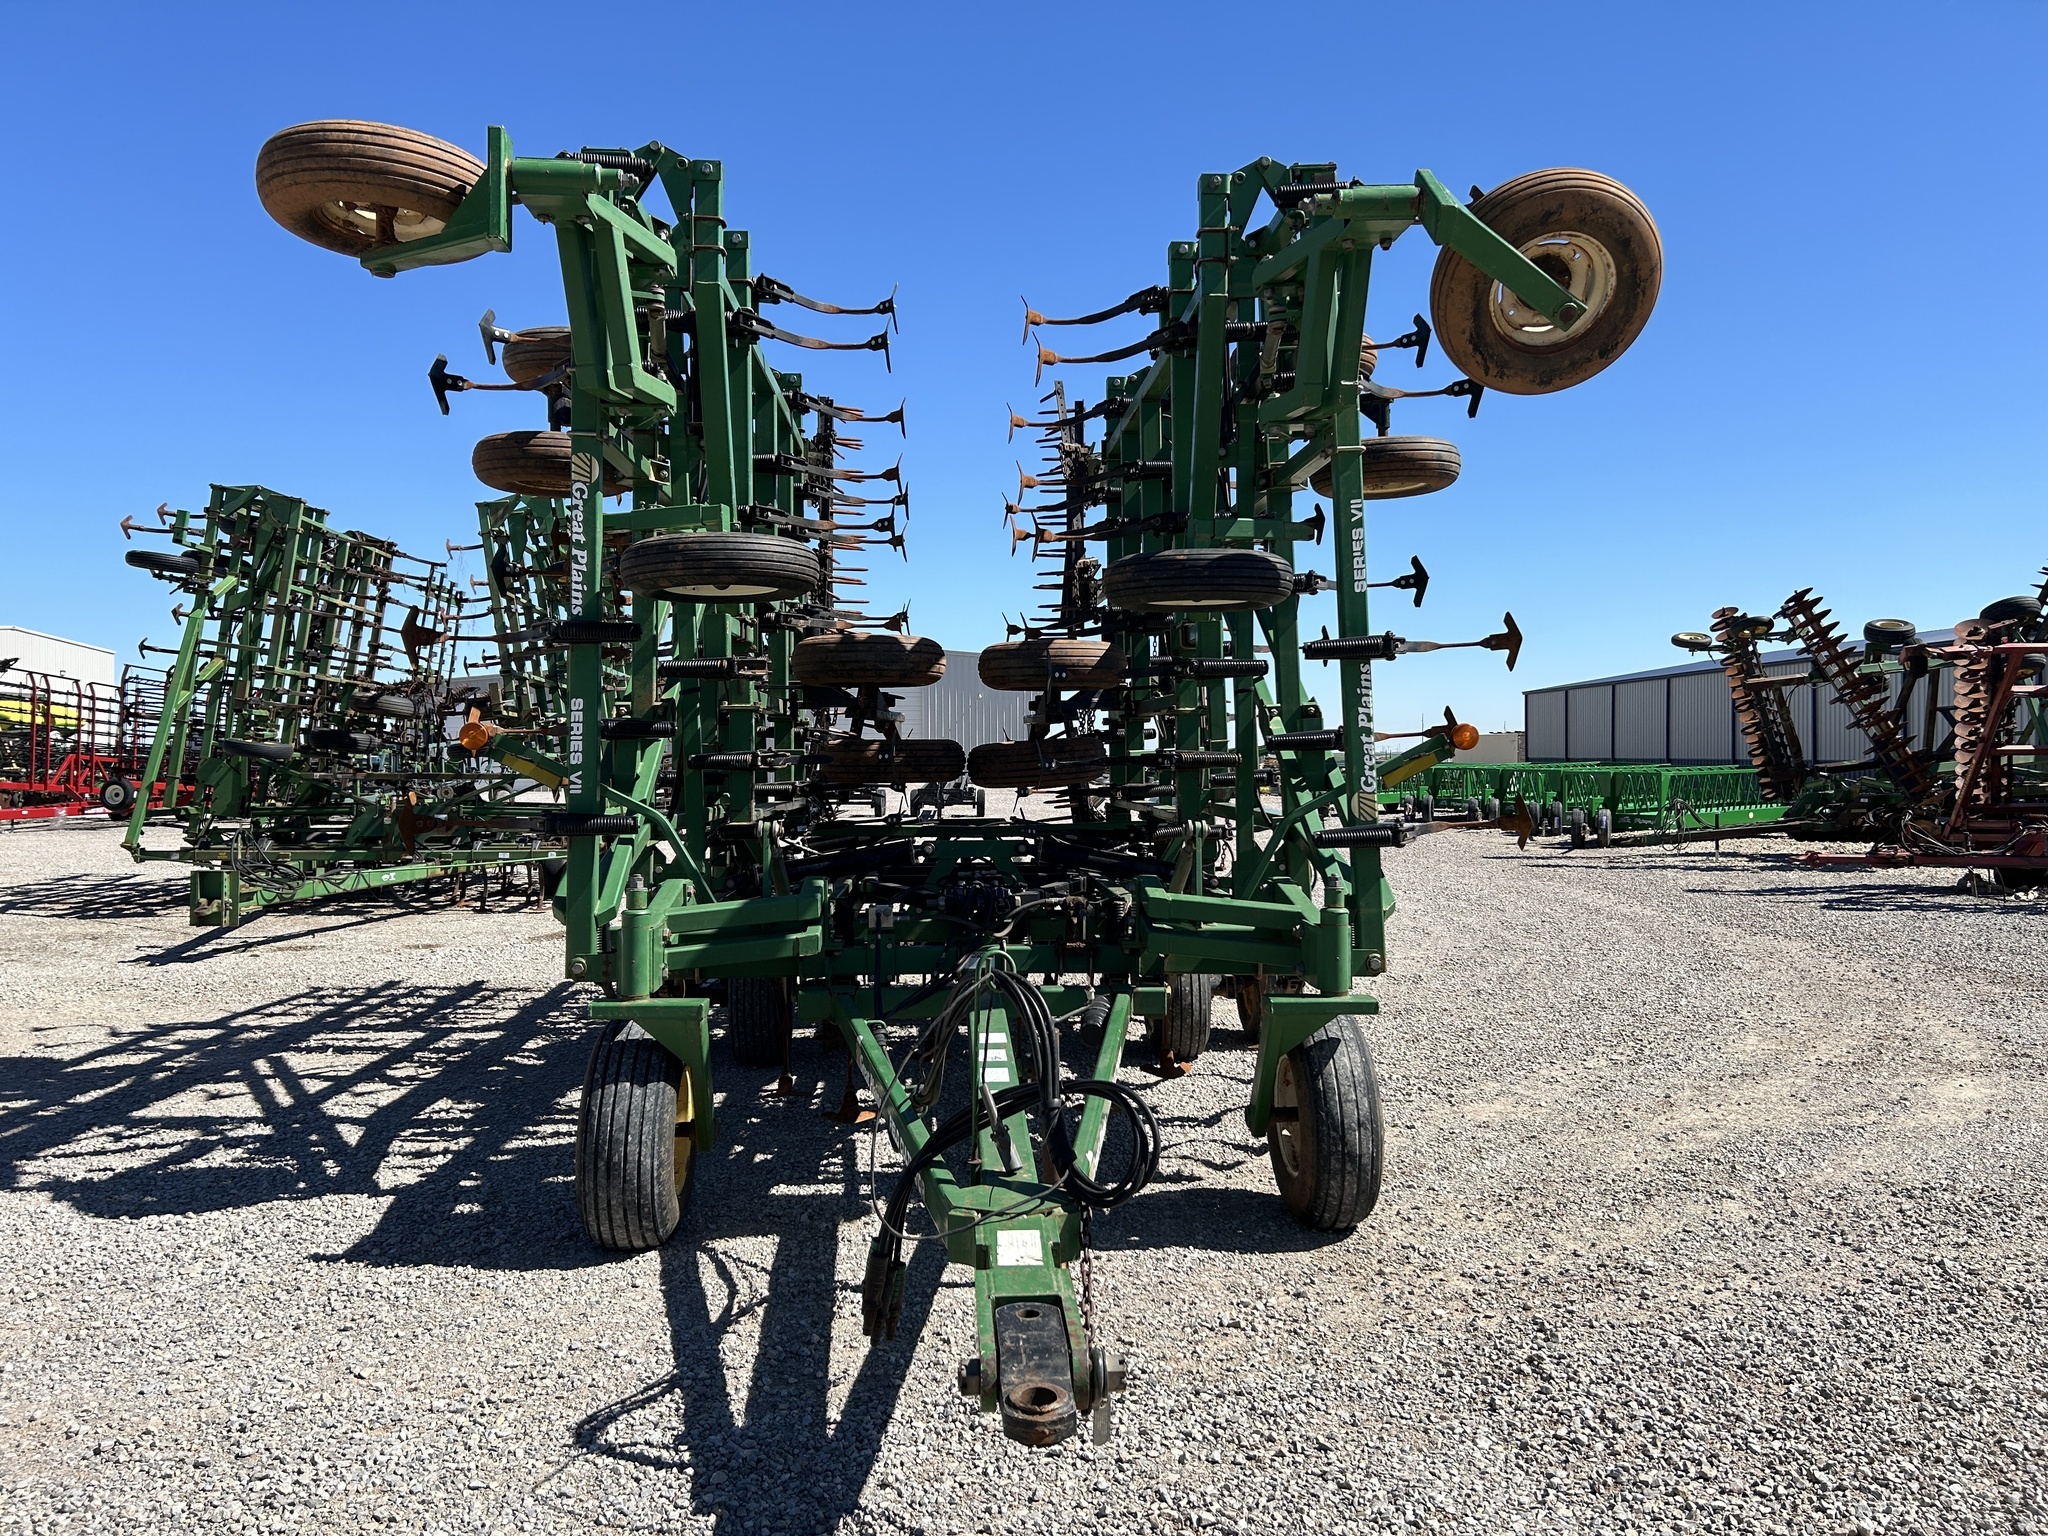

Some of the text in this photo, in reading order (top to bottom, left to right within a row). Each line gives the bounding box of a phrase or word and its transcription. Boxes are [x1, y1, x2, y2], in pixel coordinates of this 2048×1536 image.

[571, 481, 589, 616] Great Plains
[1350, 498, 1368, 593] SERIES VII
[569, 698, 584, 794] SERIES VII
[1357, 663, 1377, 794] Great Plains
